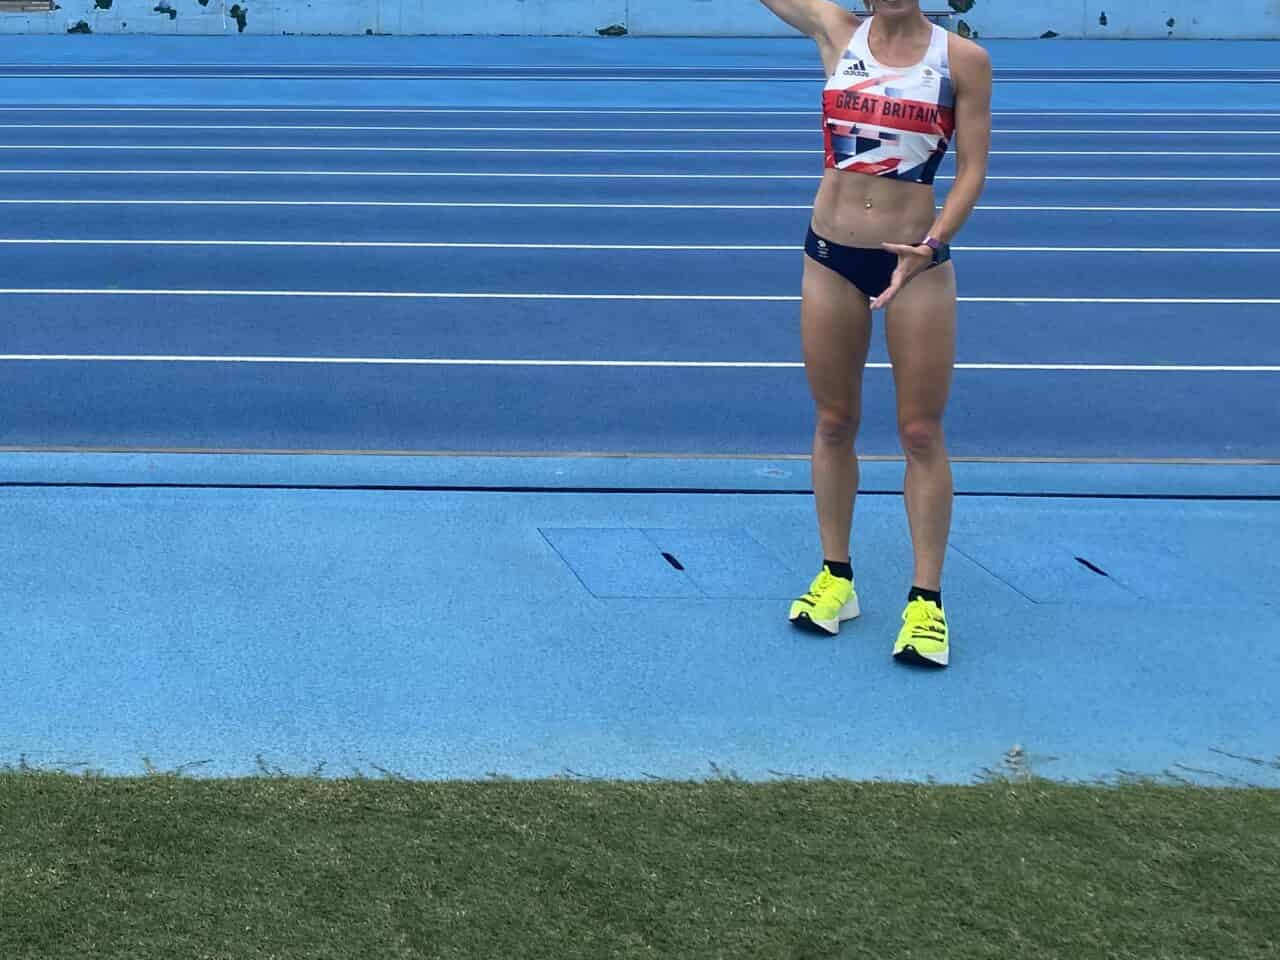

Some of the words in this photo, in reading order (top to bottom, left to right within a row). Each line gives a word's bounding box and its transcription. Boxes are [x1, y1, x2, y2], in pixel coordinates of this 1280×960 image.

[843, 69, 870, 77] adidas
[835, 93, 877, 114] GREAT
[882, 100, 939, 124] BRITAIN
